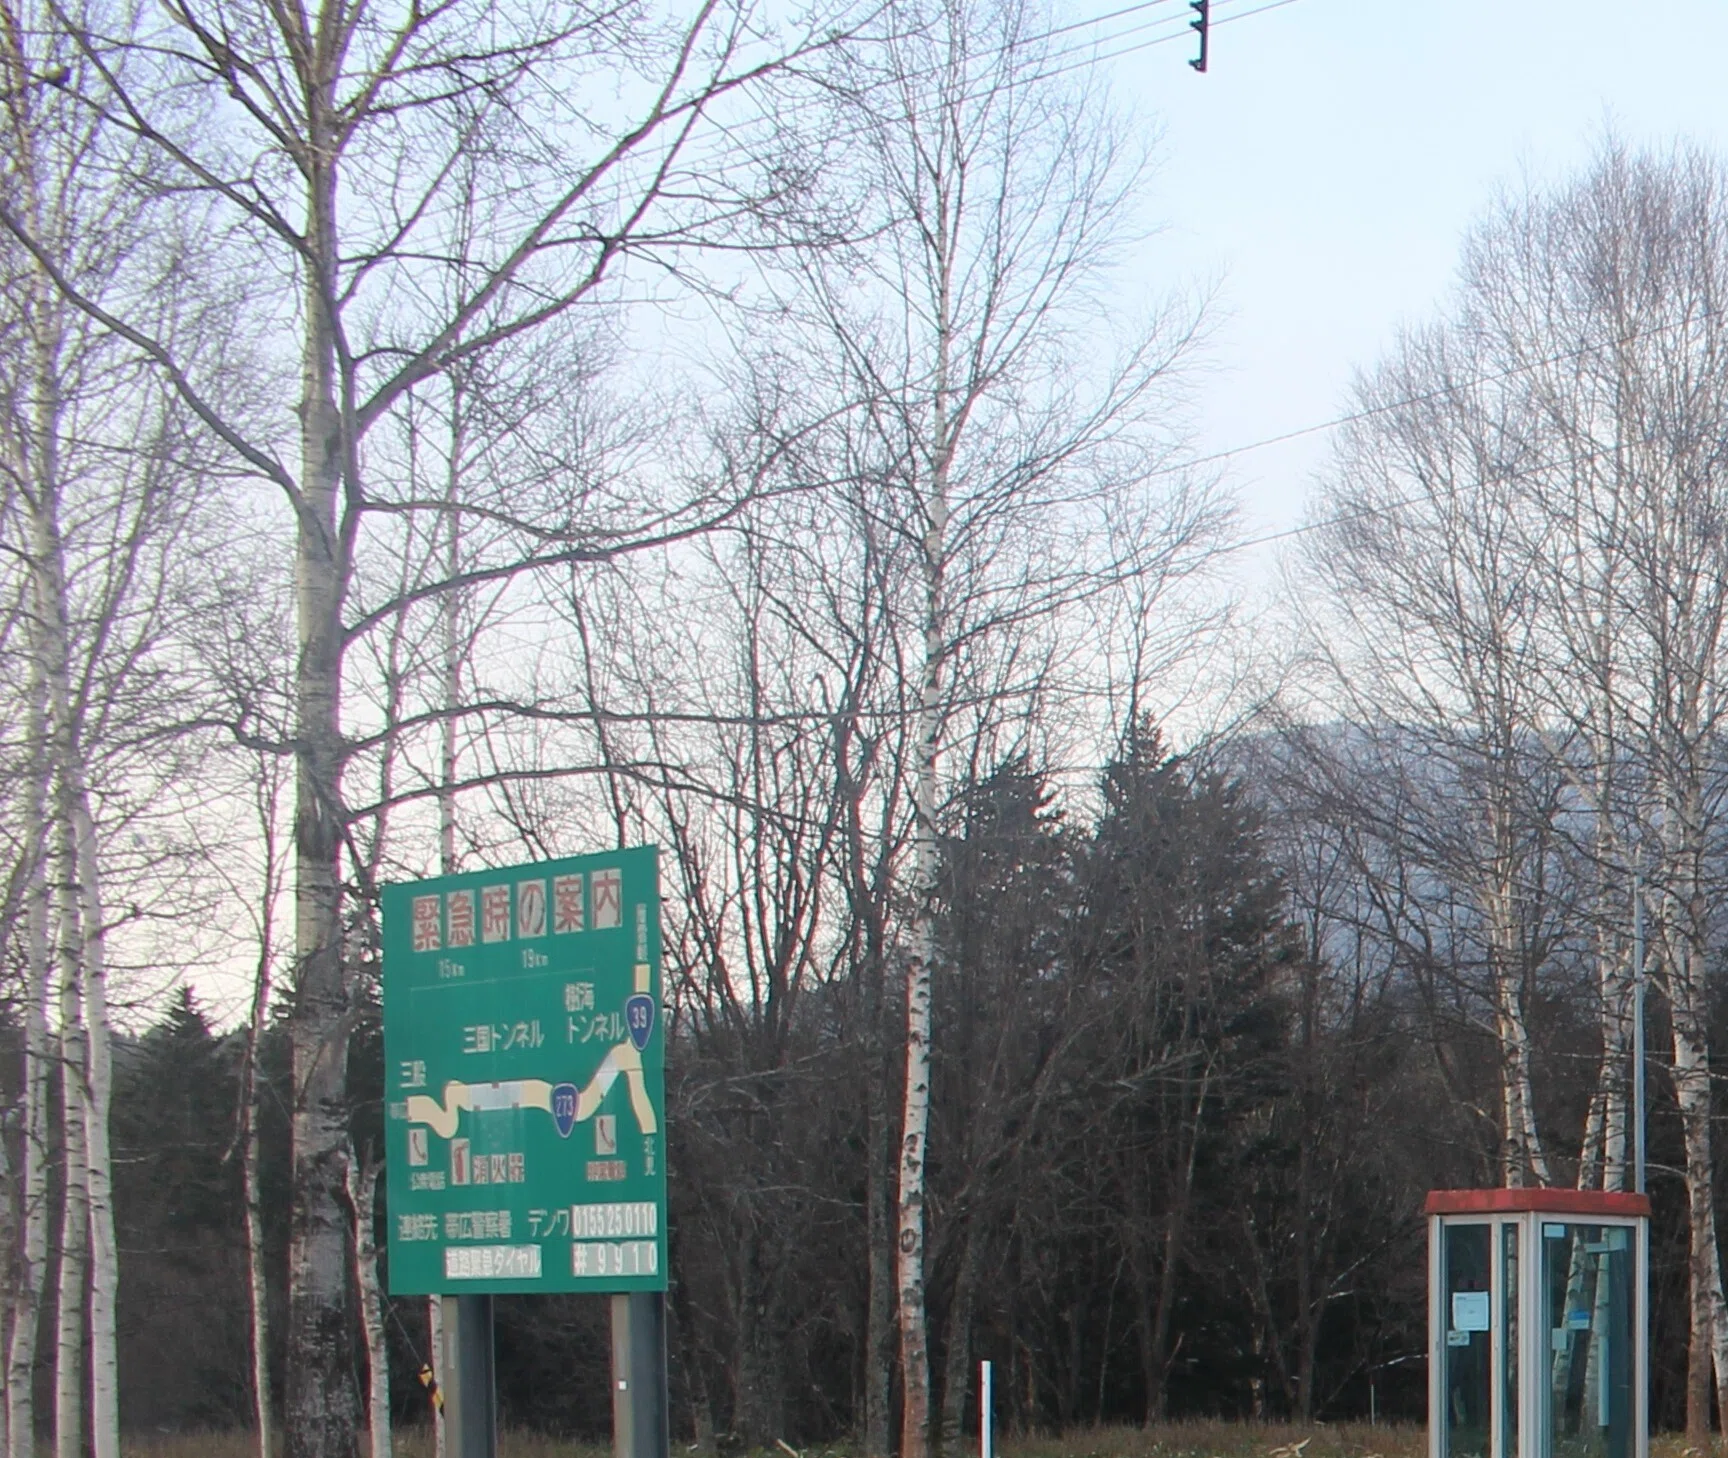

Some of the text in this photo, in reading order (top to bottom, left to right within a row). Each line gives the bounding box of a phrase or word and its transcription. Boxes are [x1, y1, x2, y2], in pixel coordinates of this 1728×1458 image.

[413, 869, 622, 951] 緊急時の案内
[568, 1012, 625, 1044] トンネル
[632, 1006, 647, 1029] 39
[463, 1020, 545, 1054] 三国トンネル
[555, 1095, 573, 1117] 273
[528, 1208, 569, 1237] デンワ
